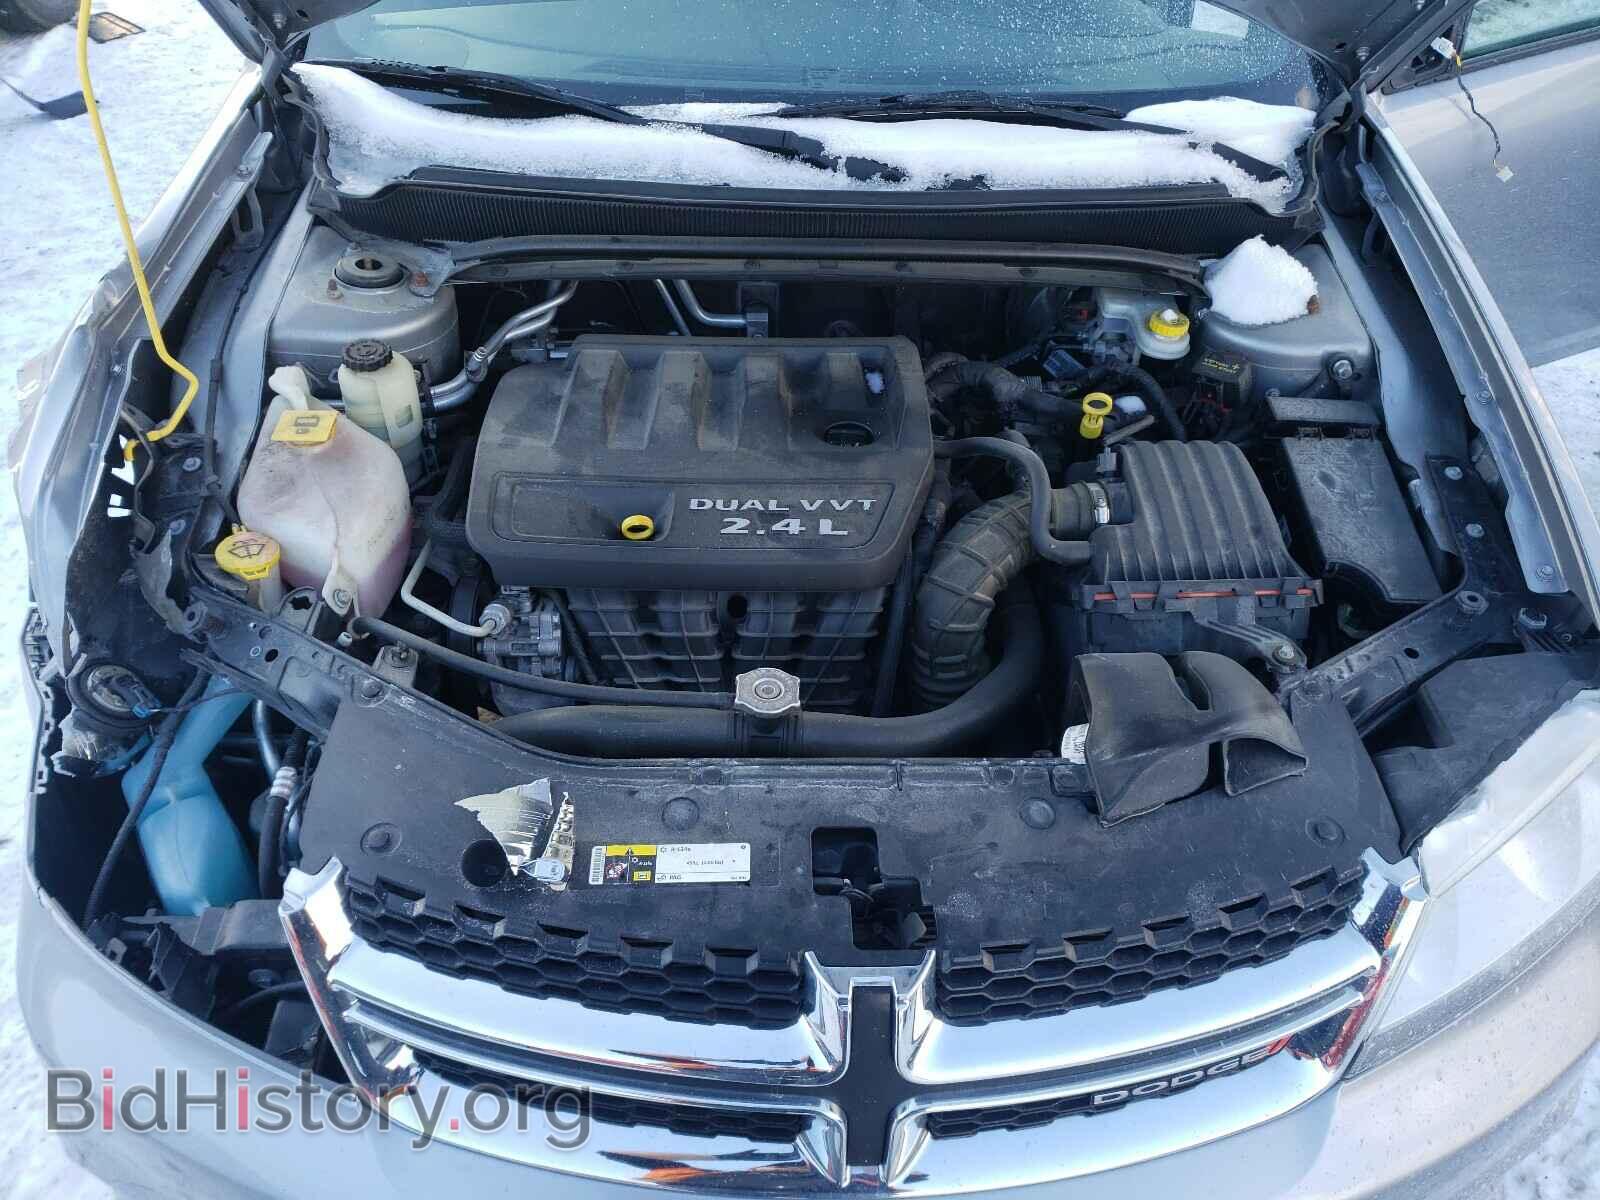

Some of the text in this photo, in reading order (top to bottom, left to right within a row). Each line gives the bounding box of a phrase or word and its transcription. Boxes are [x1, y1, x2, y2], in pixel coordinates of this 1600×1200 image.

[688, 498, 877, 511] DUAL VVT
[1093, 1049, 1270, 1105] DODGE
